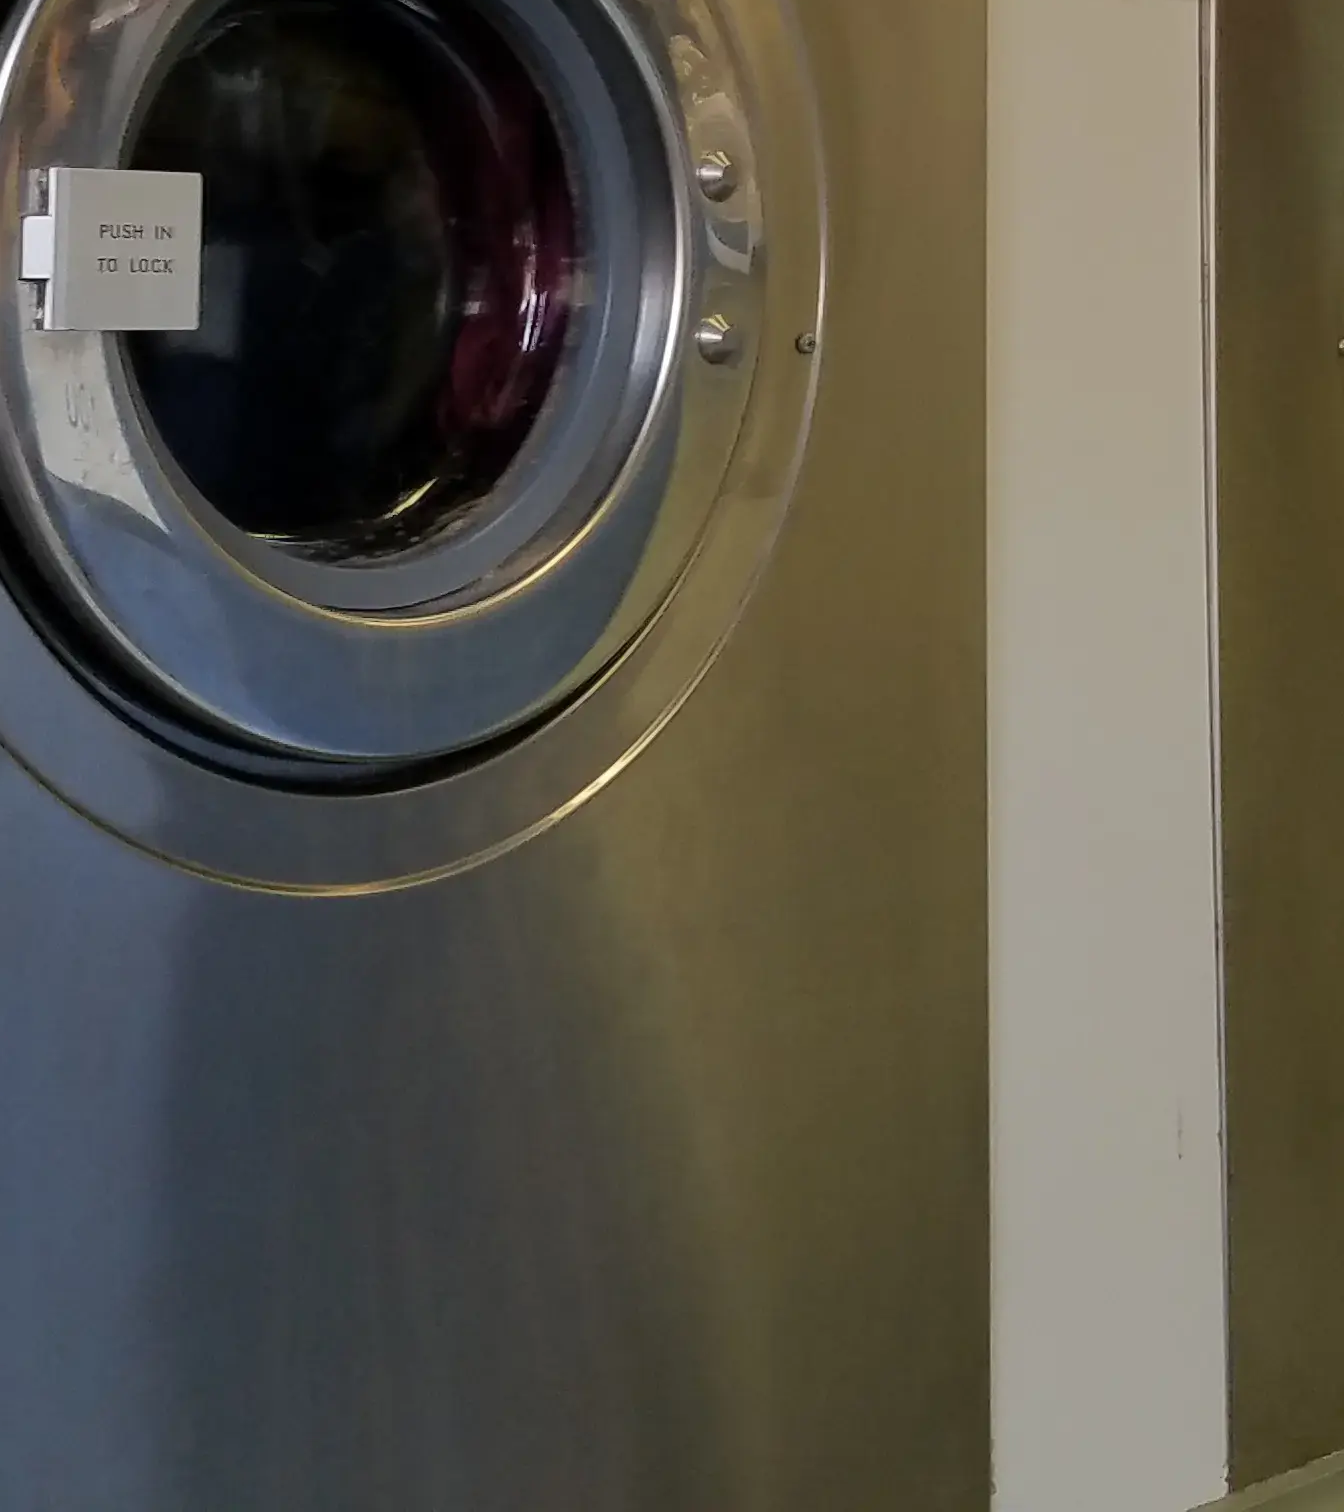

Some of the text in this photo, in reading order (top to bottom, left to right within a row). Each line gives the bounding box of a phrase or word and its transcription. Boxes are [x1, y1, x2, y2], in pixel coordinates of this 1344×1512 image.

[99, 223, 173, 240] PUSH IN
[97, 257, 173, 274] TO LOCK
